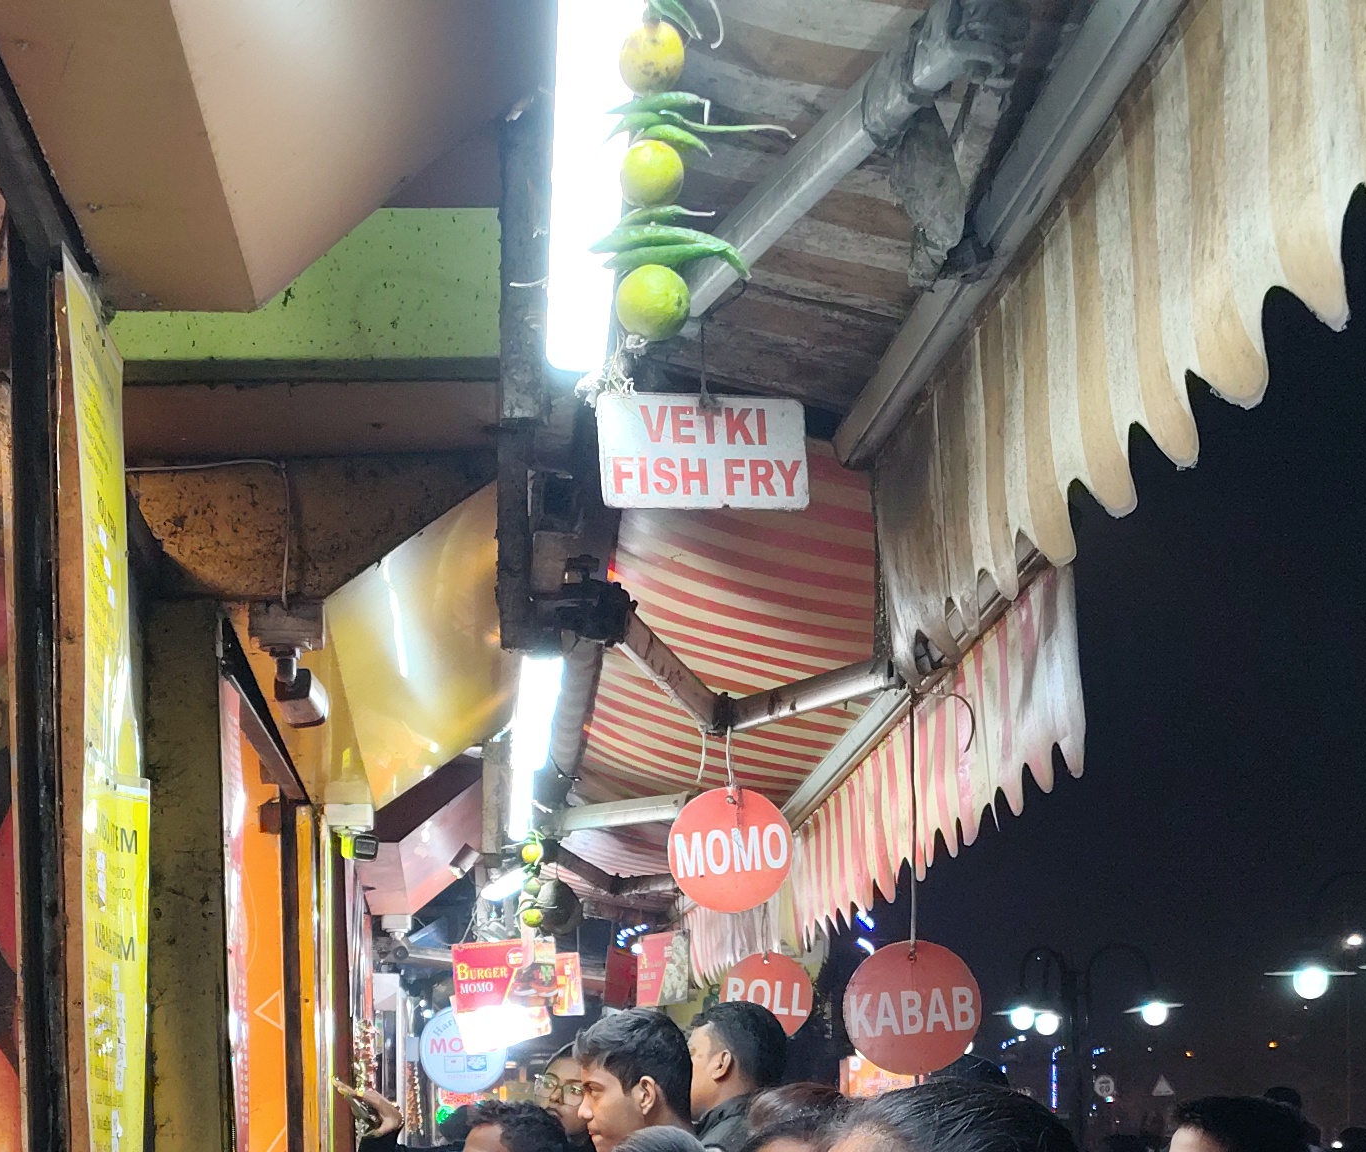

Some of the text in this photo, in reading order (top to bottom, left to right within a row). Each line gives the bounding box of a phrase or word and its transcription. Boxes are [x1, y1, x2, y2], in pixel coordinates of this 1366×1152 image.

[639, 405, 767, 445] VETKI
[612, 456, 802, 497] FISH FRY
[674, 823, 788, 879] MOMO
[456, 963, 508, 981] BURGER
[460, 981, 494, 995] MOMO
[727, 976, 807, 1016] ROLL
[849, 986, 975, 1039] KABAB
